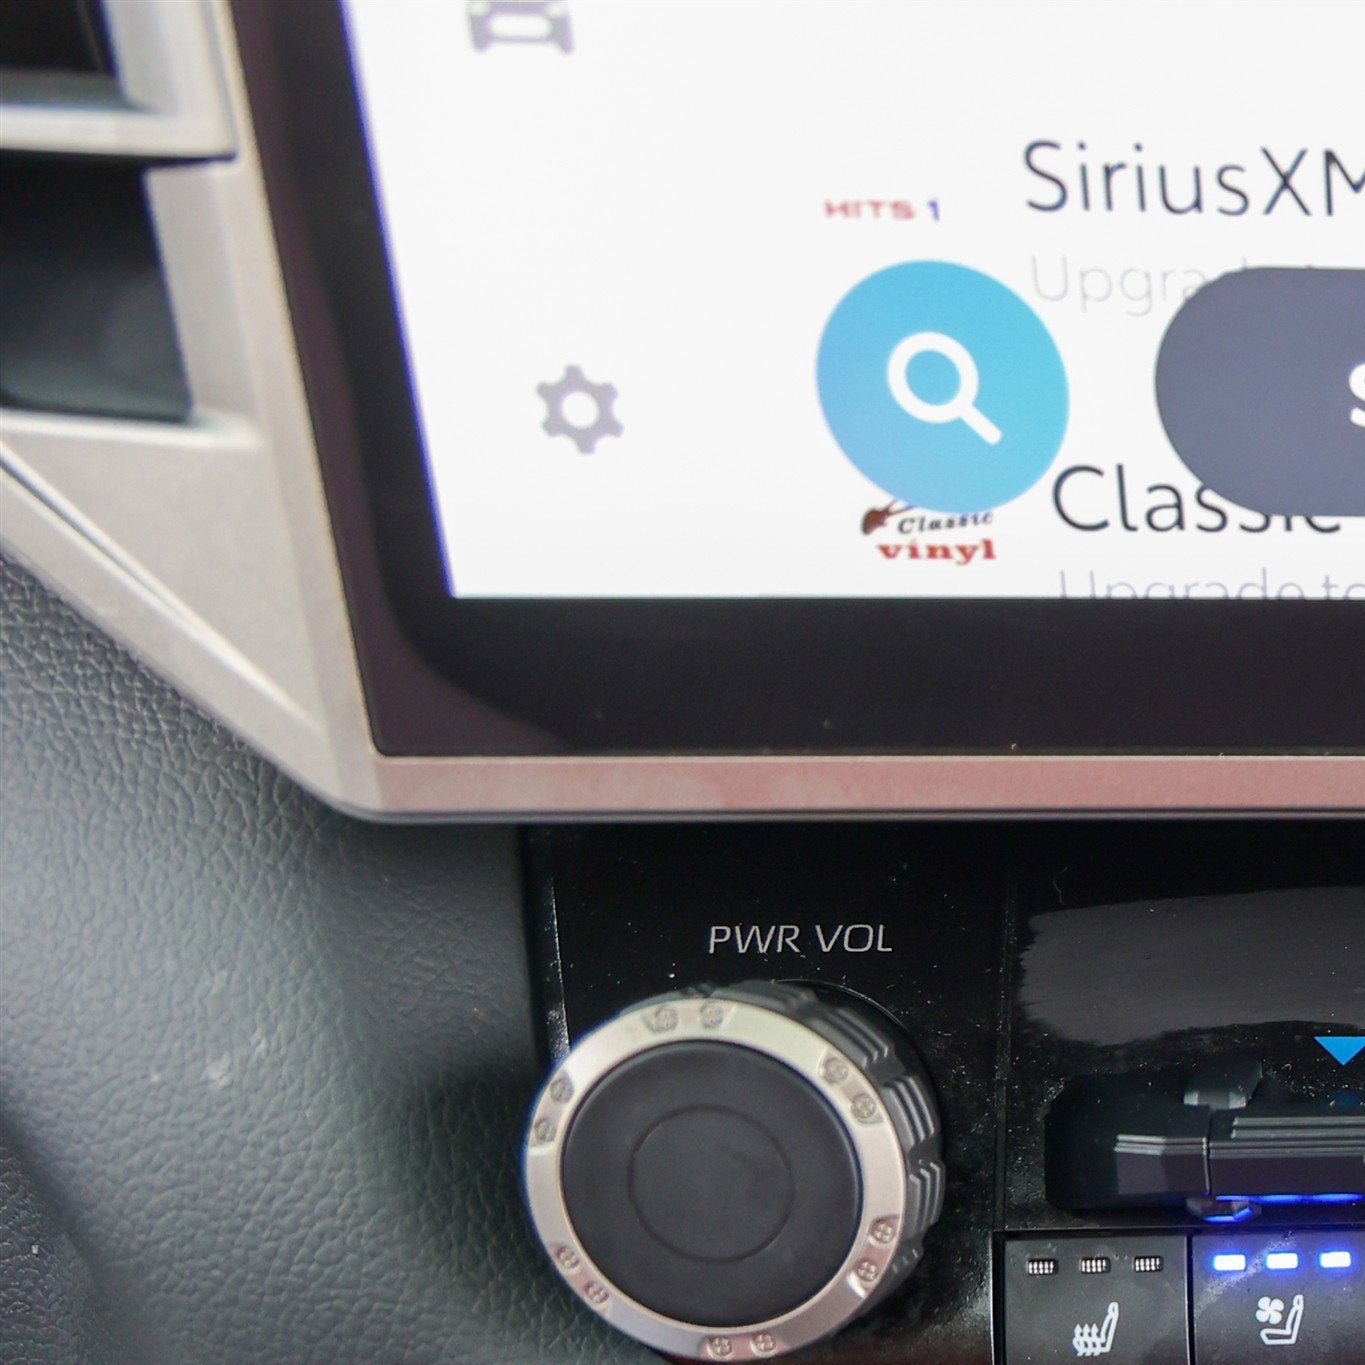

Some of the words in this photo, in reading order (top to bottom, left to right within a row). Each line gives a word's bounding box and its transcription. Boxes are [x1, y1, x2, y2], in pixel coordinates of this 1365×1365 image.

[823, 198, 916, 221] HITS
[927, 197, 940, 222] 1
[897, 511, 993, 534] Classic
[877, 538, 996, 566] vinyl
[708, 924, 802, 955] PWR
[815, 923, 894, 954] VOL
